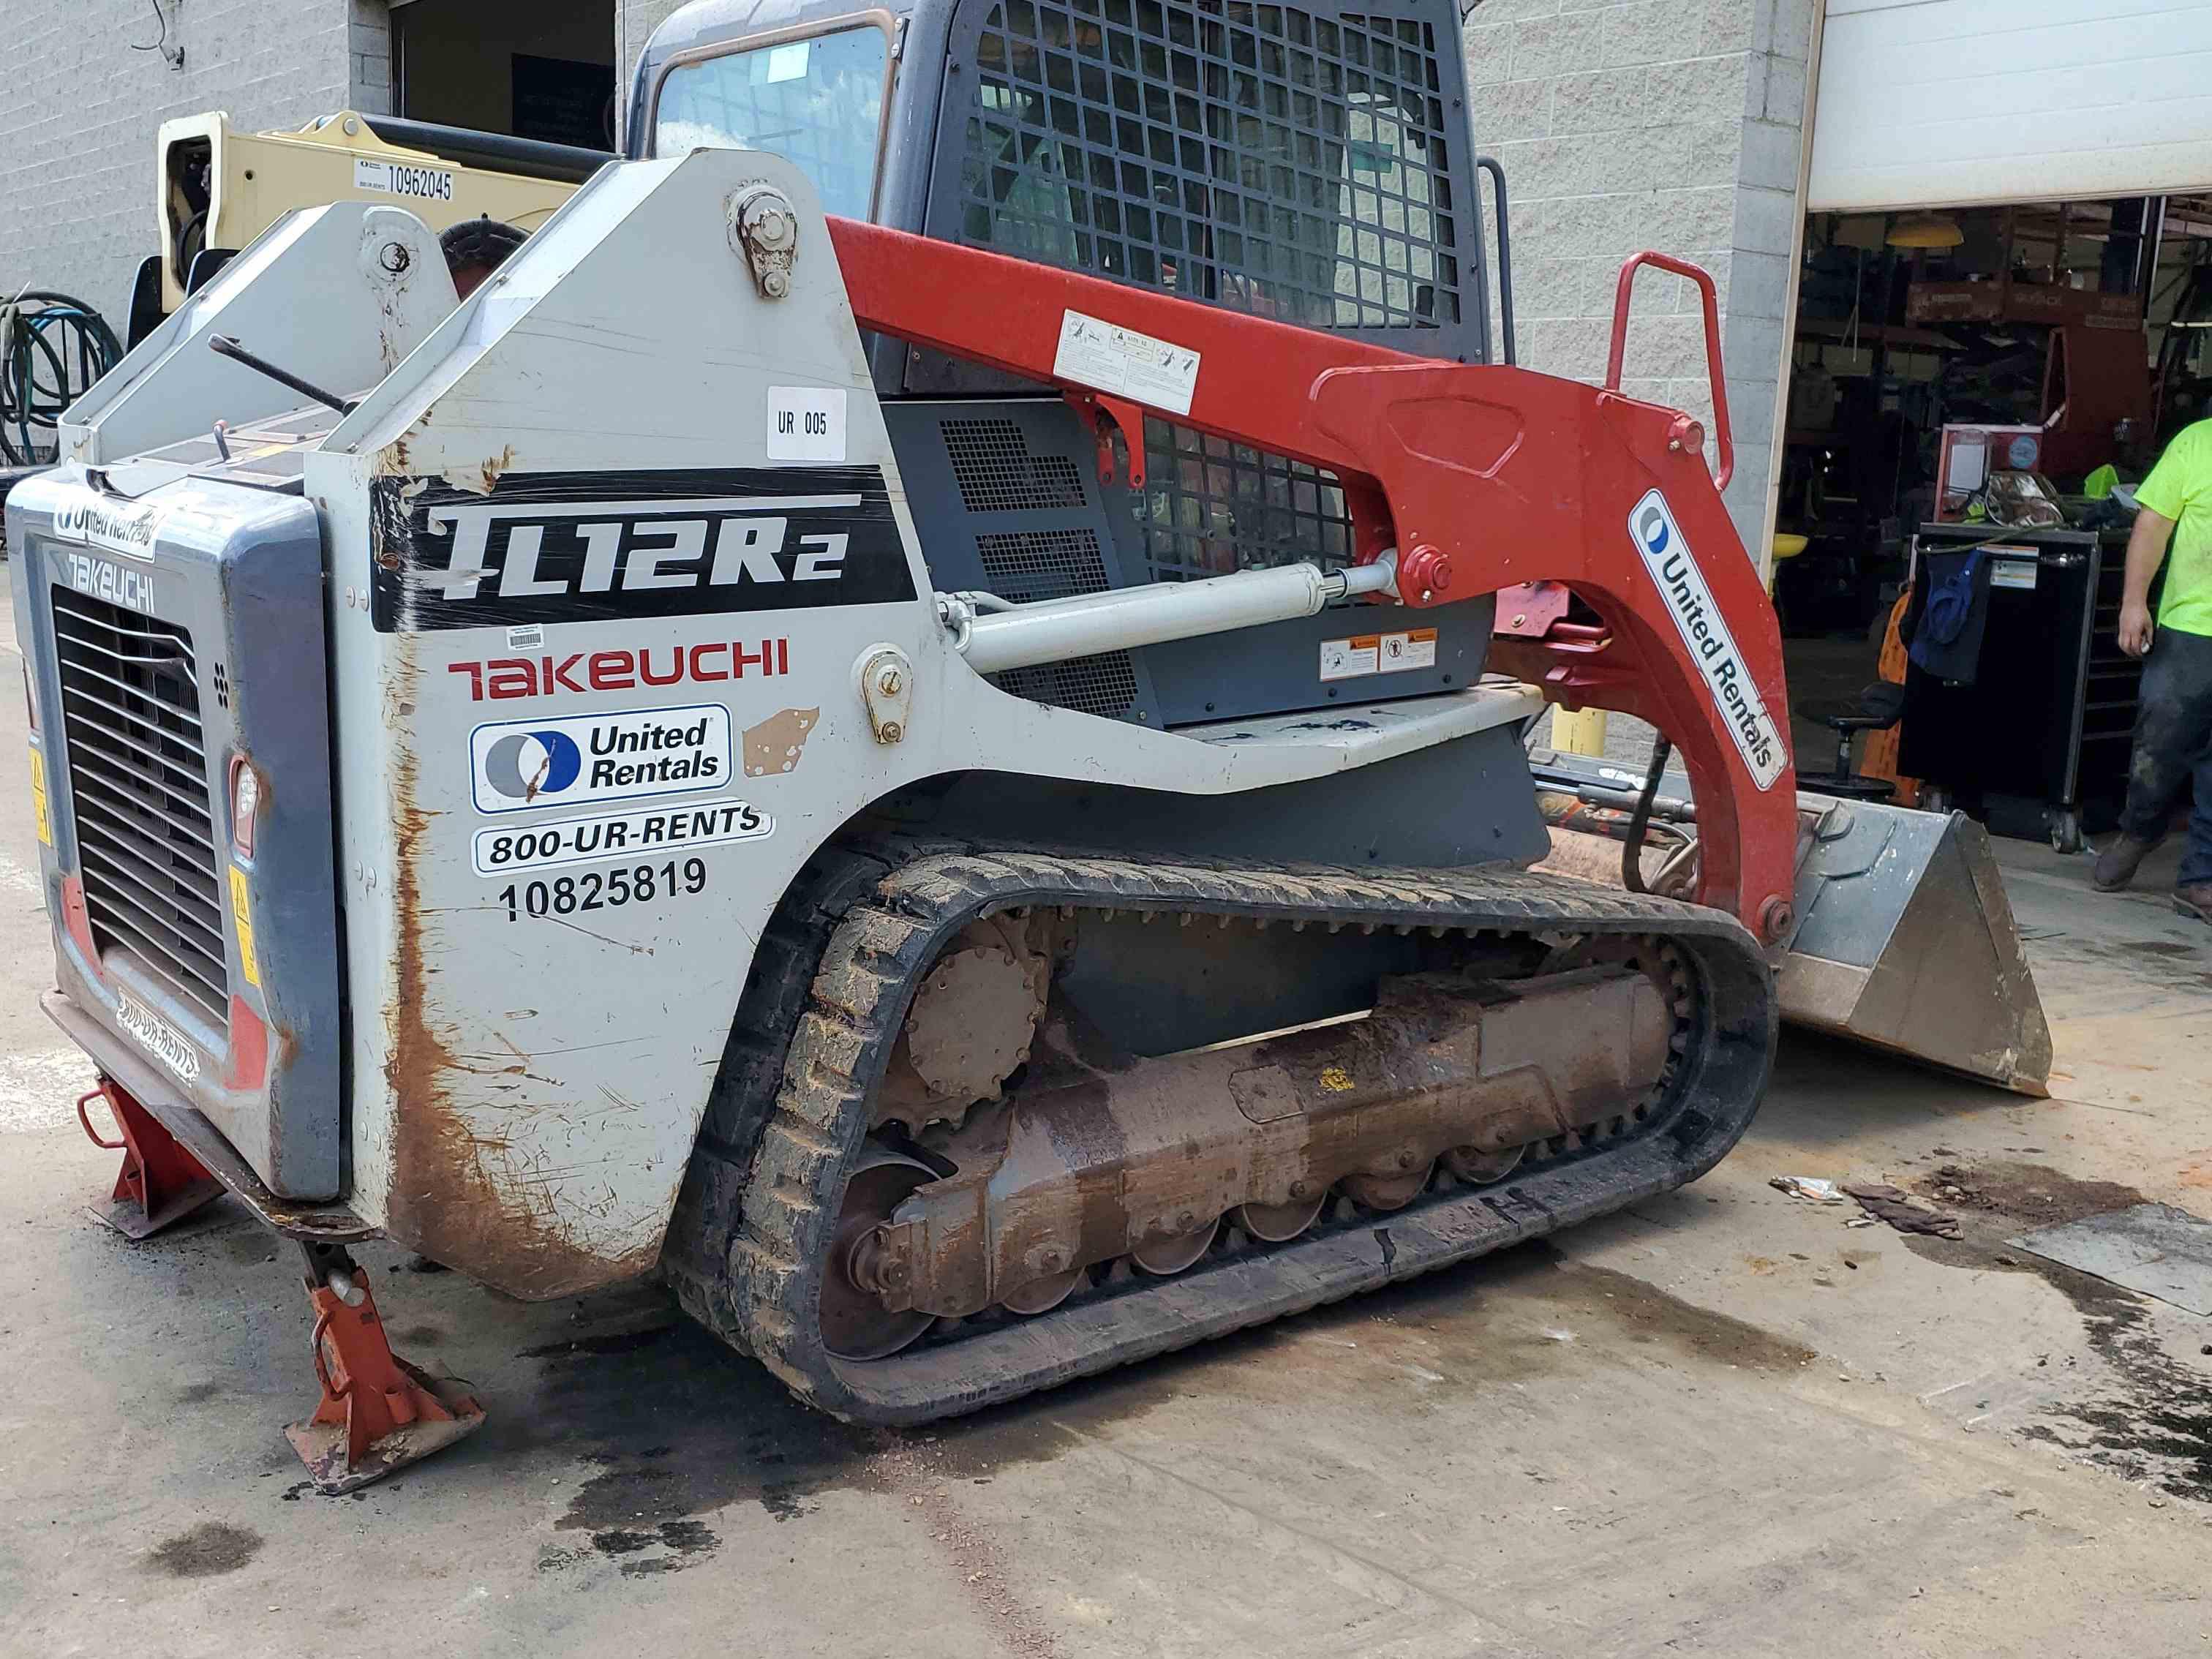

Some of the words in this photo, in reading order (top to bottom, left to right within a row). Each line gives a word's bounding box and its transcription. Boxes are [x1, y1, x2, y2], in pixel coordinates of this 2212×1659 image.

[388, 165, 451, 200] 10962045
[778, 410, 794, 434] UR
[805, 411, 827, 435] 005
[1662, 552, 1725, 661] United
[1712, 657, 1772, 769] Rentals
[590, 718, 708, 756] United
[590, 750, 719, 789] Rentals
[489, 804, 762, 865] 800-UR-RENTS
[498, 857, 707, 923] 10825819
